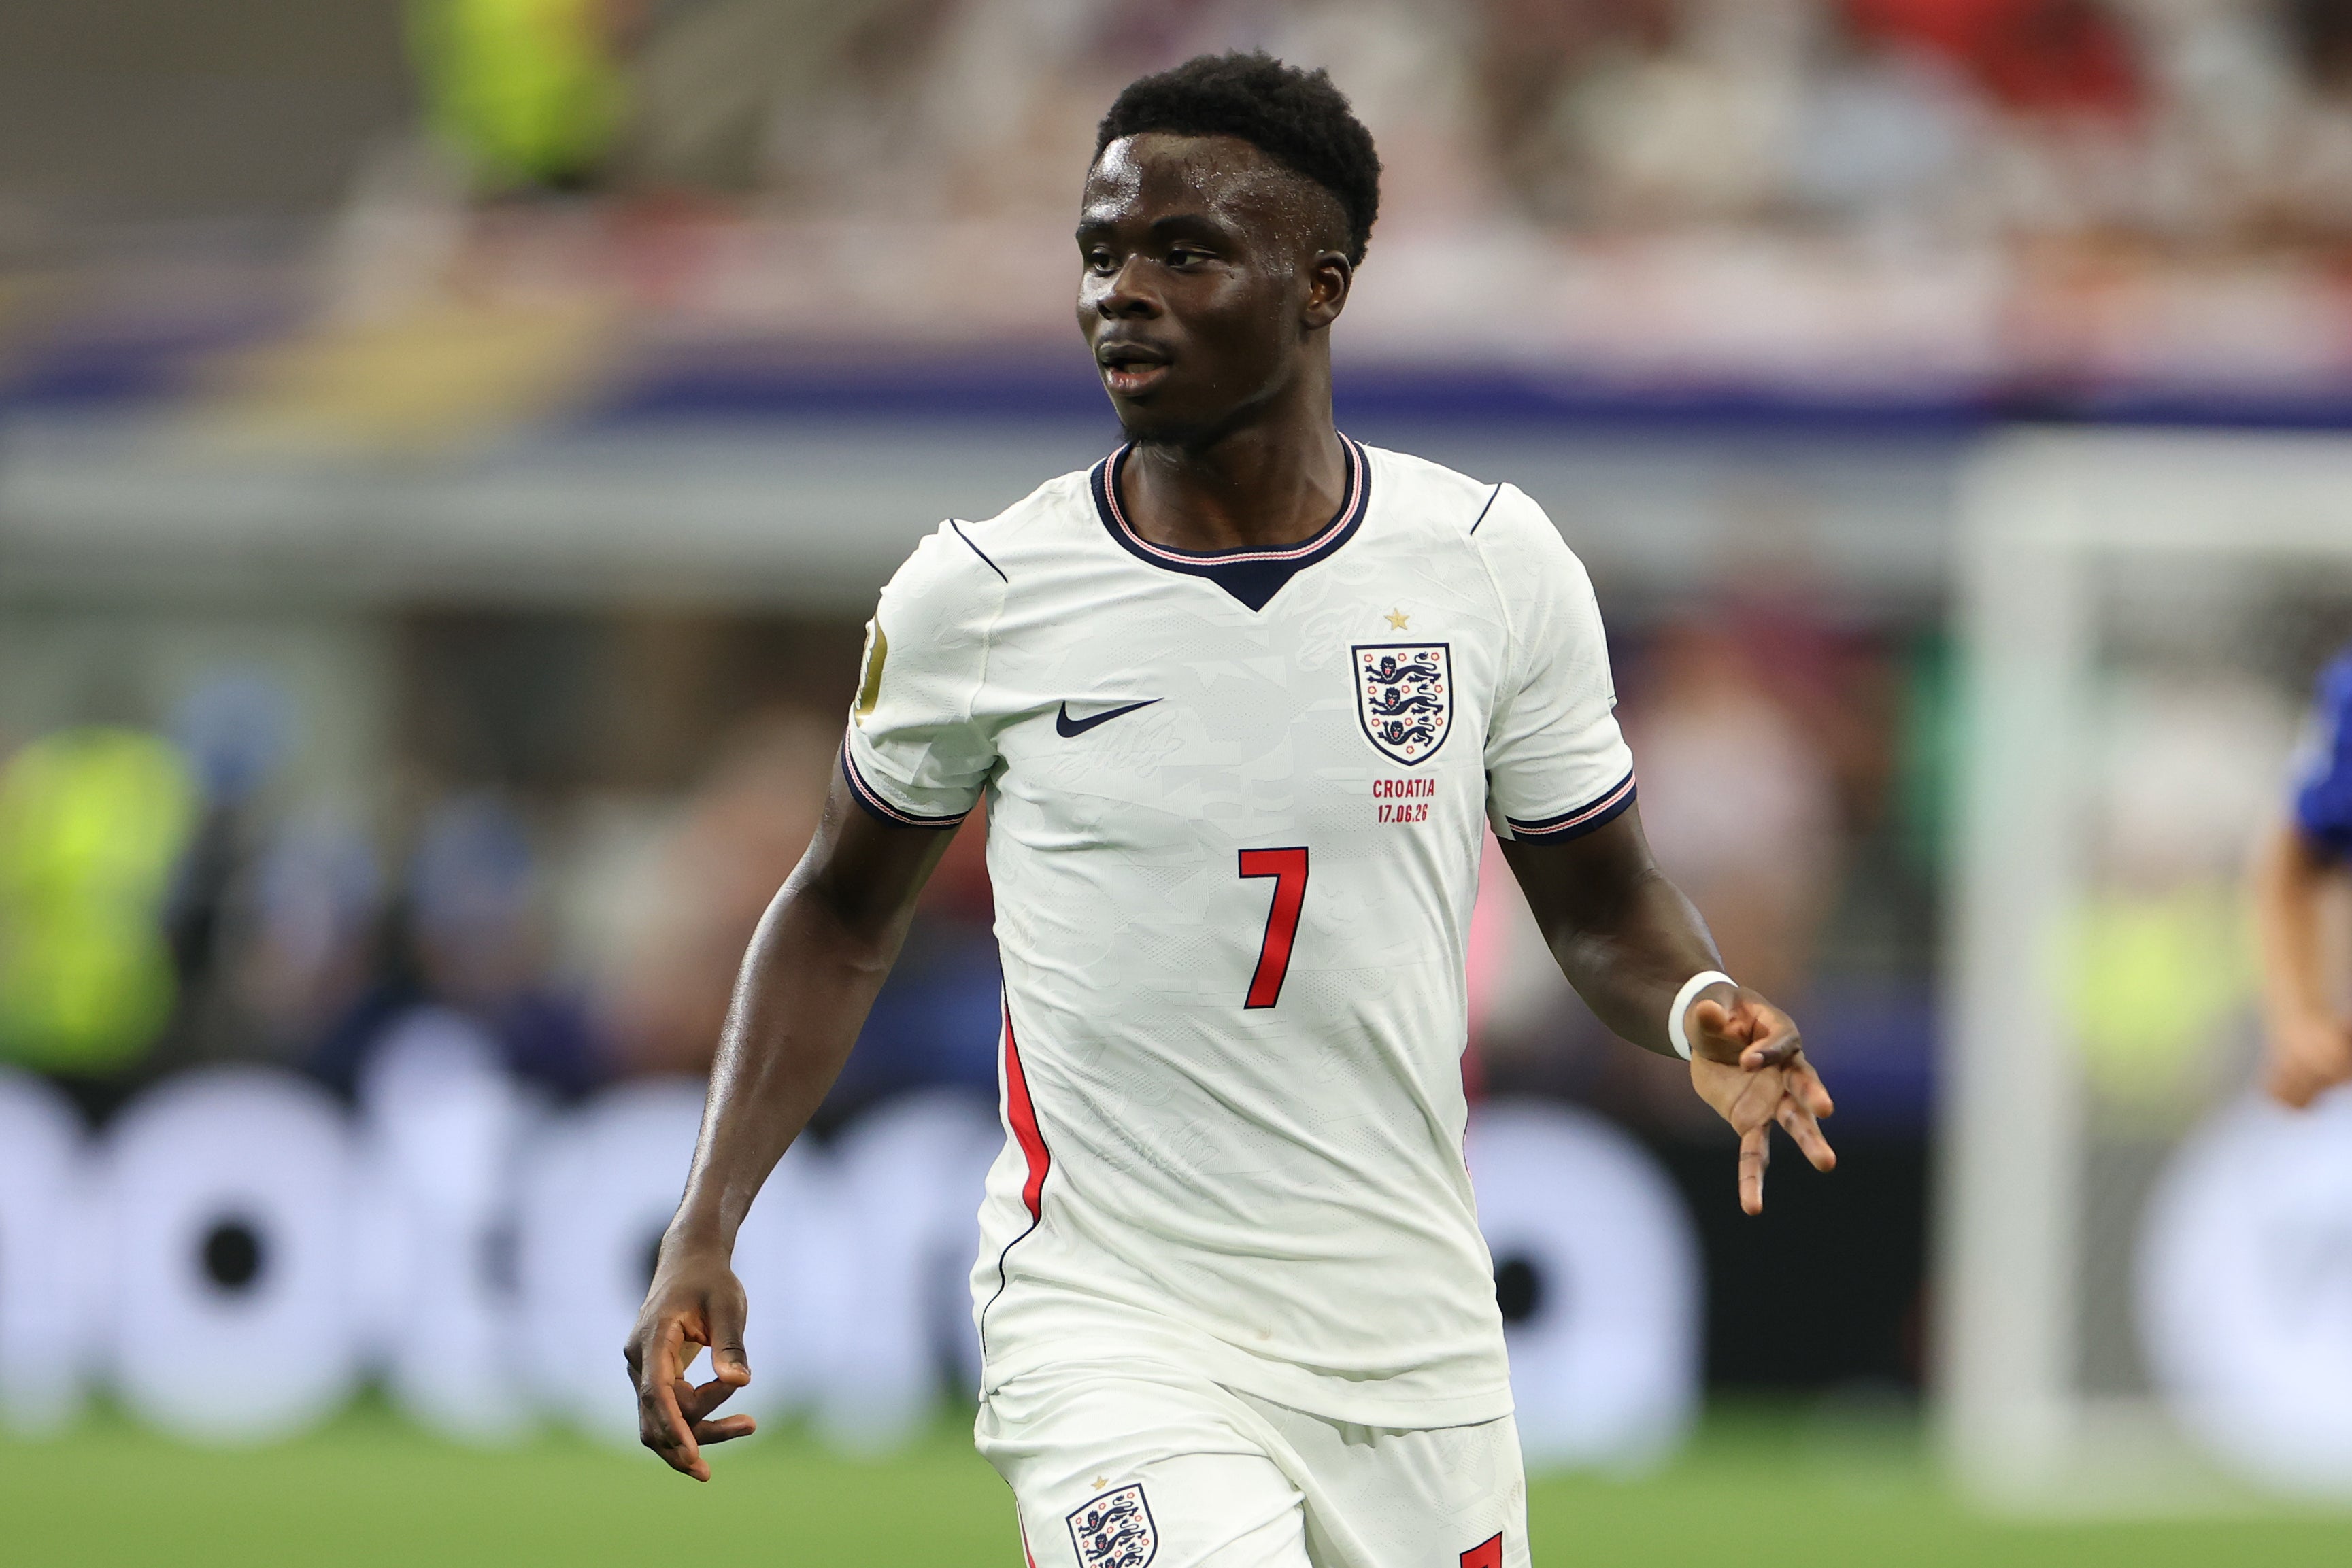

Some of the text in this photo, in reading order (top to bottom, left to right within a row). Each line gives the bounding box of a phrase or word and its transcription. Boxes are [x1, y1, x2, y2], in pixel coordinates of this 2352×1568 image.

[1373, 779, 1434, 798] CROATIA
[1378, 803, 1428, 823] 17.06.26
[1238, 846, 1309, 1010] 7
